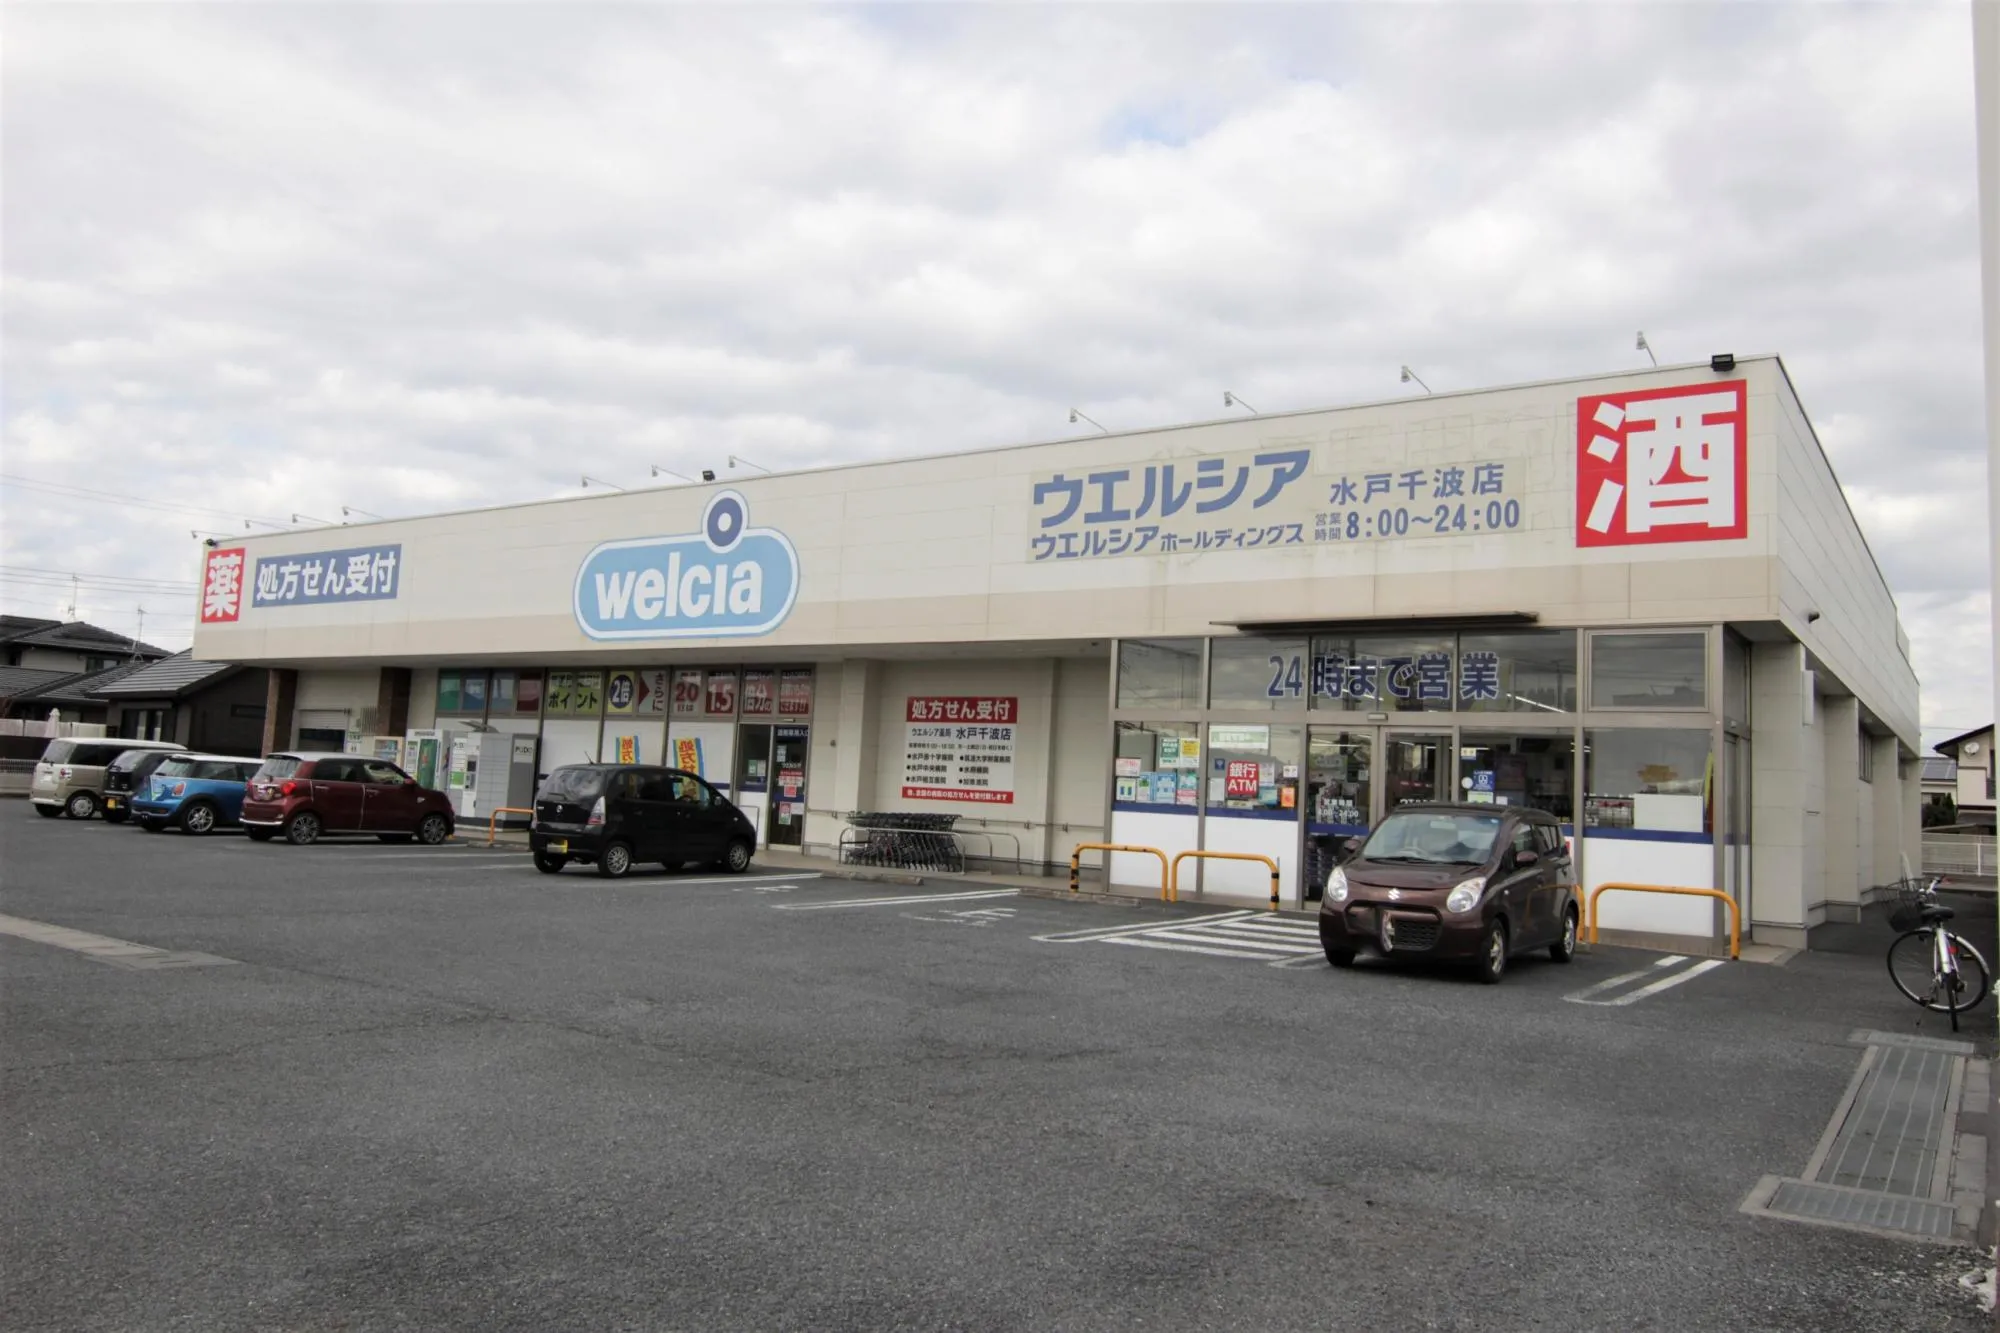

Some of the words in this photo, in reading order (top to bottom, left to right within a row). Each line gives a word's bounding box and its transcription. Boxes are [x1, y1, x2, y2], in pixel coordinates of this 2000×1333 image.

[1586, 391, 1737, 534] 酒
[1033, 449, 1311, 528] ウエルシア
[1329, 463, 1506, 506] 水戸千波店
[204, 554, 242, 618] 薬
[256, 551, 396, 601] 処方せん受付
[595, 552, 762, 621] welcia
[612, 679, 631, 704] 2倍
[676, 684, 699, 702] 20
[1267, 651, 1500, 700] 24時まで営業
[548, 691, 598, 710] ポイント
[912, 700, 1010, 720] 処方せん受付
[1227, 778, 1257, 792] ATM
[1229, 762, 1257, 778] 銀行
